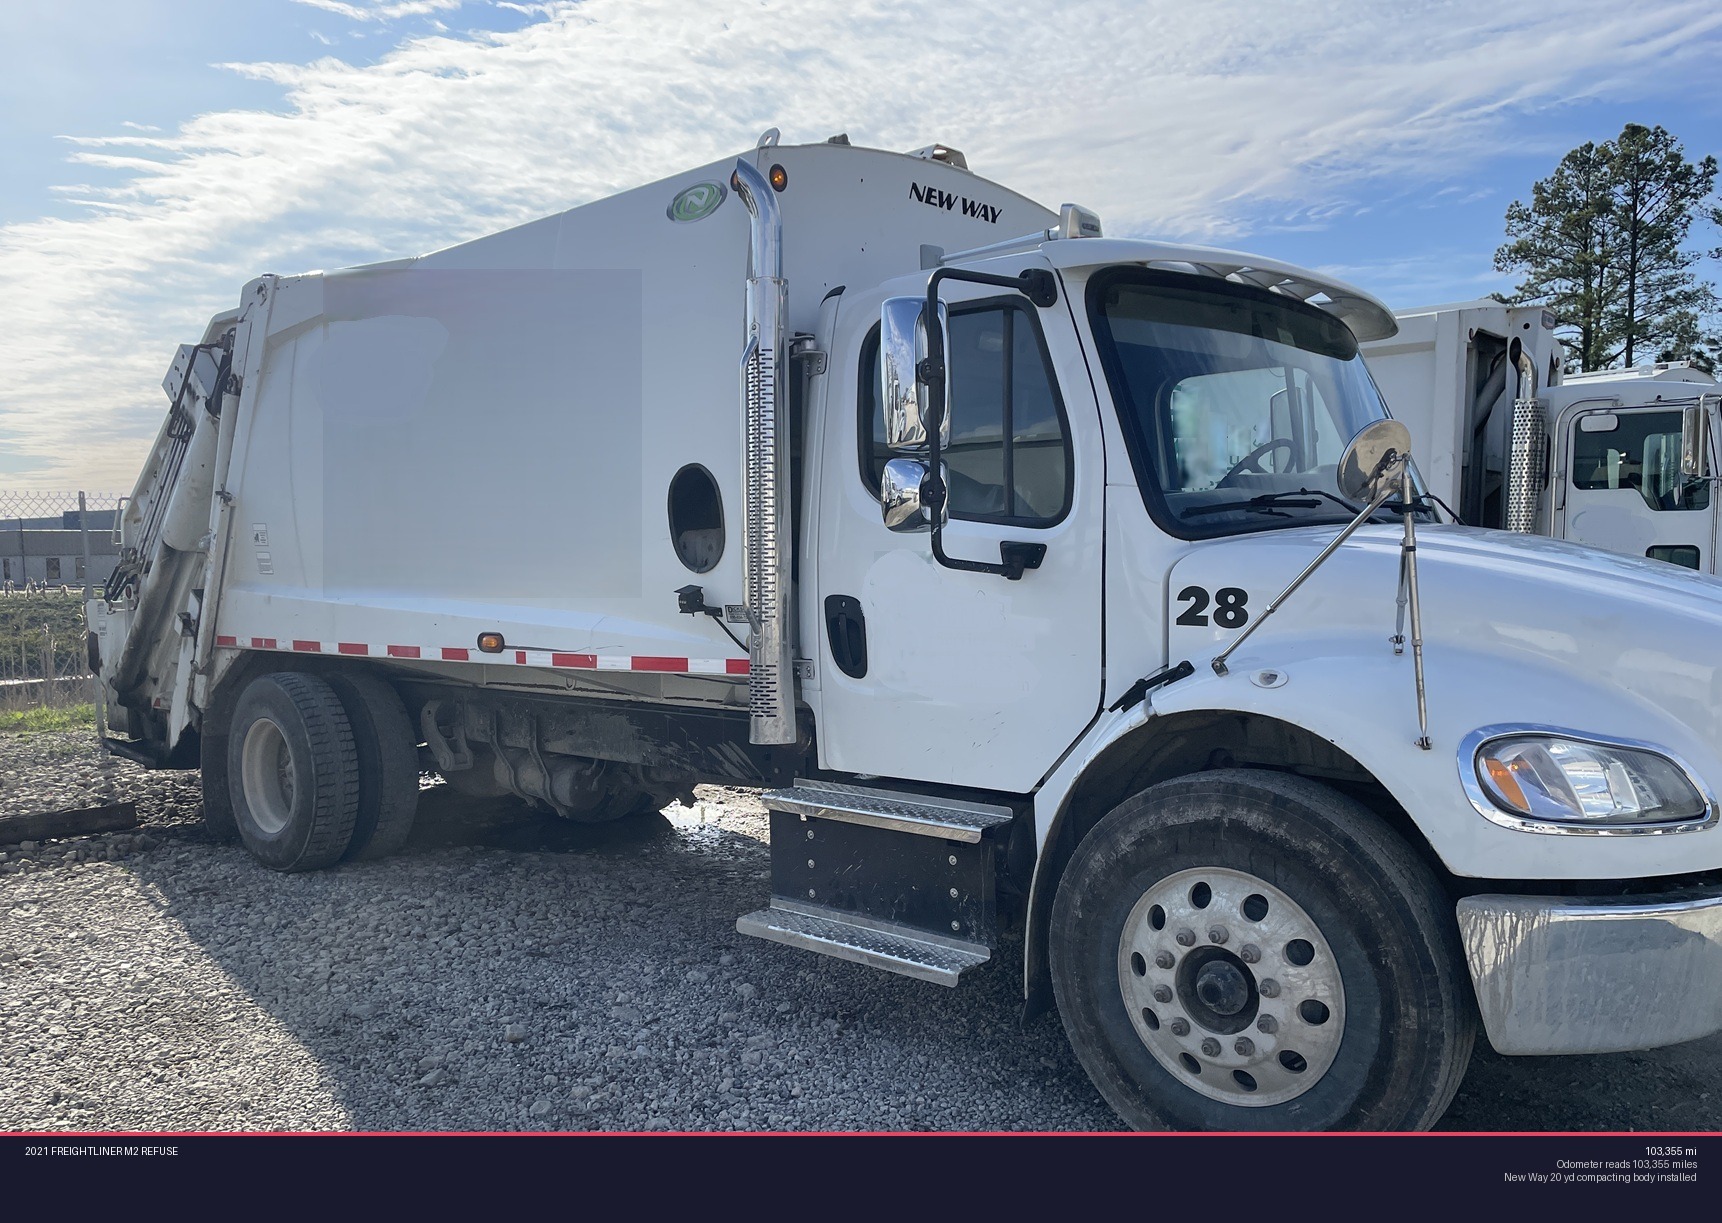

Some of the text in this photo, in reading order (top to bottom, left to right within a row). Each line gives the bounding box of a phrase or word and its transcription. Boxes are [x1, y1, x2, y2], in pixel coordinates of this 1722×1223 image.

[909, 181, 1003, 224] NEW WAY
[1175, 585, 1249, 629] 28
